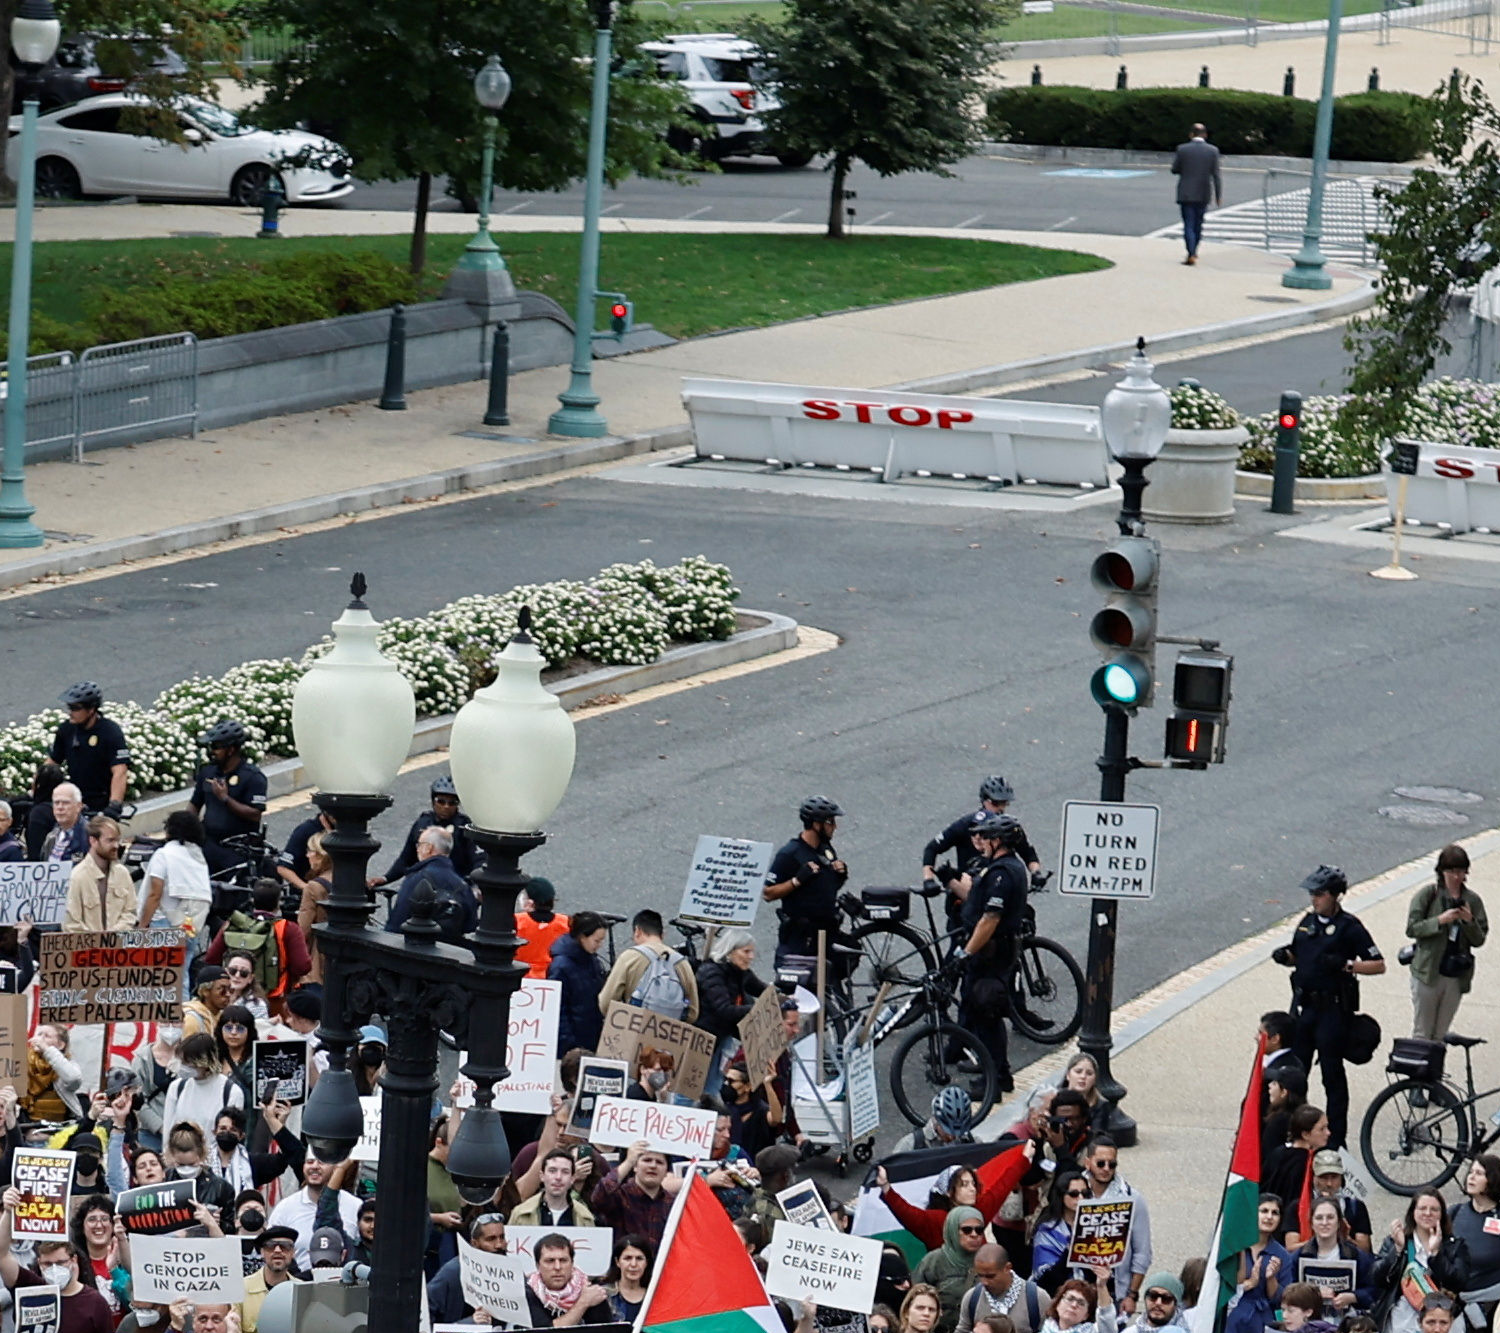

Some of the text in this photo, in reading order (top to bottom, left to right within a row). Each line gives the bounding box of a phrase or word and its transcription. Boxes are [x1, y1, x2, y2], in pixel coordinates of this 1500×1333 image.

[802, 400, 974, 429] STOP
[1097, 813, 1123, 827] NO
[1084, 833, 1137, 850] TURN
[1070, 854, 1146, 871] ON RED
[43, 951, 181, 968] TO GENOCIDE
[40, 970, 79, 990] STOP
[41, 1003, 180, 1021] FREE PALESTINE
[596, 1103, 714, 1149] FREE PALESTINE
